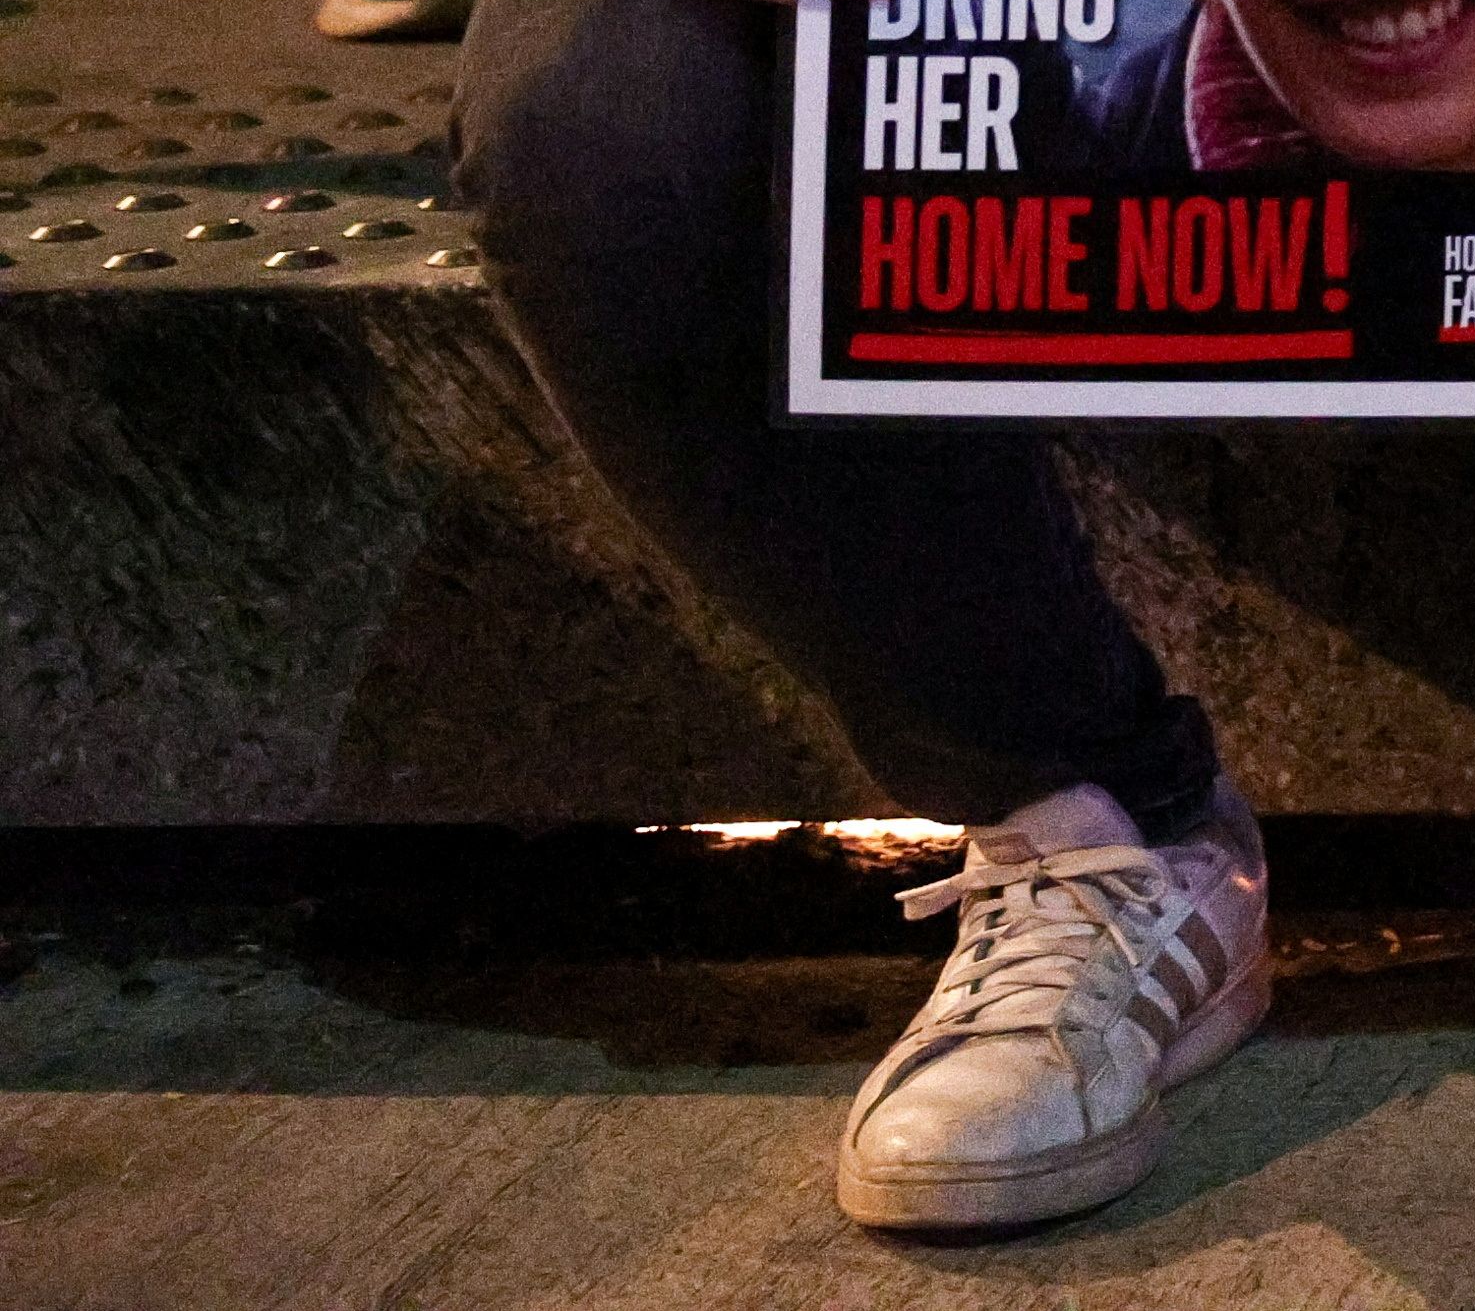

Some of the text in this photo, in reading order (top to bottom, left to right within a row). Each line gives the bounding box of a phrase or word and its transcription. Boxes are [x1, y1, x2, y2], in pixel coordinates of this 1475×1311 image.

[864, 55, 1020, 171] HER
[860, 181, 1350, 312] HOME NOW!
